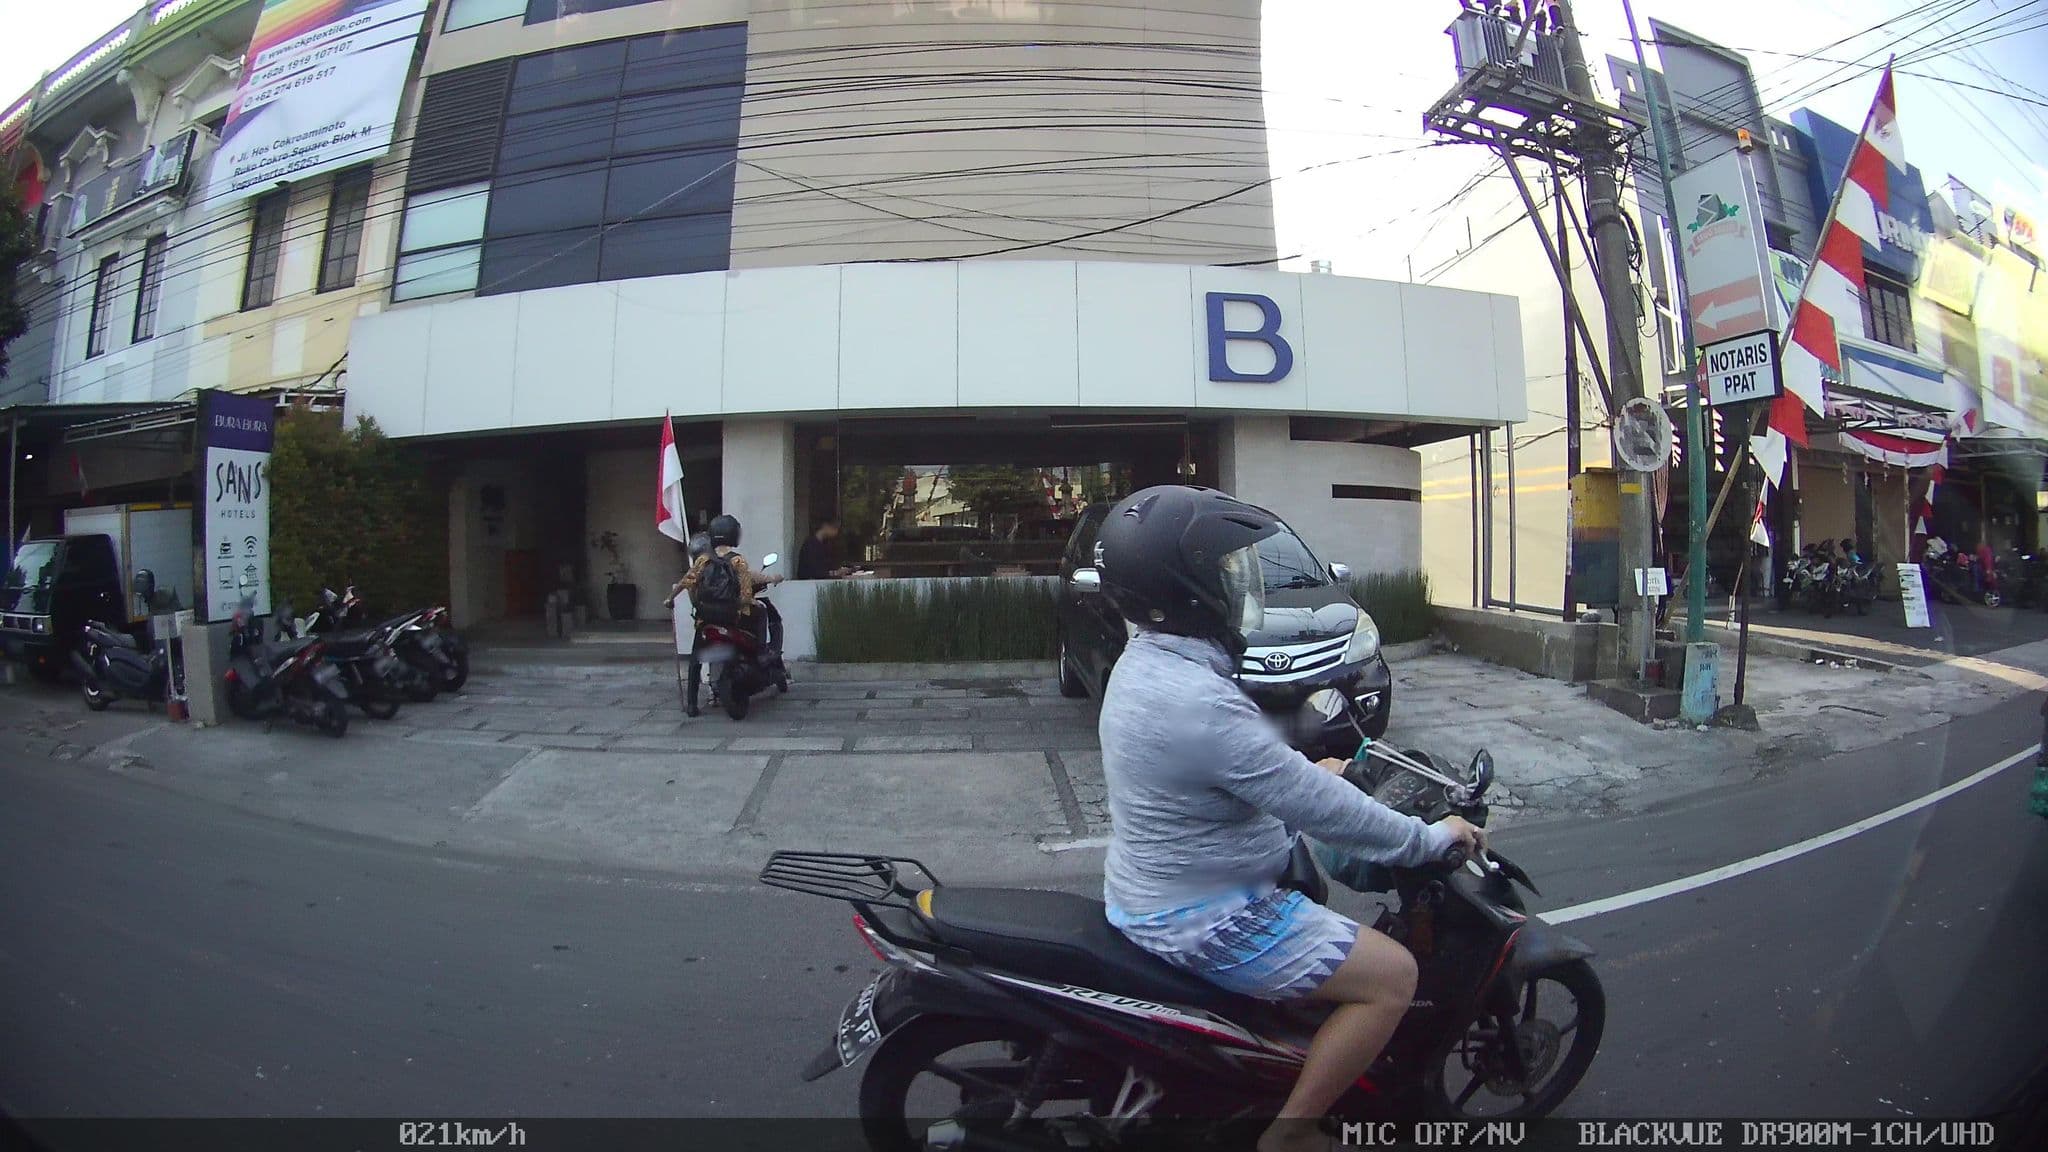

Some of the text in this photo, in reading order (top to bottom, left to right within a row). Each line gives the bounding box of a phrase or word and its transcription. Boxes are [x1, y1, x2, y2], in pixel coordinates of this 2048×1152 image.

[268, 16, 372, 59] www.ckptextile.com
[315, 40, 353, 60] 107107
[273, 82, 292, 95] 274
[316, 66, 336, 80] 517
[273, 120, 346, 150] Cokroaminoto
[1206, 292, 1293, 383] B
[1710, 343, 1767, 373] NOTARIS
[1724, 371, 1756, 394] PPAT
[216, 460, 262, 504] SANS
[220, 509, 256, 519] HOTELS
